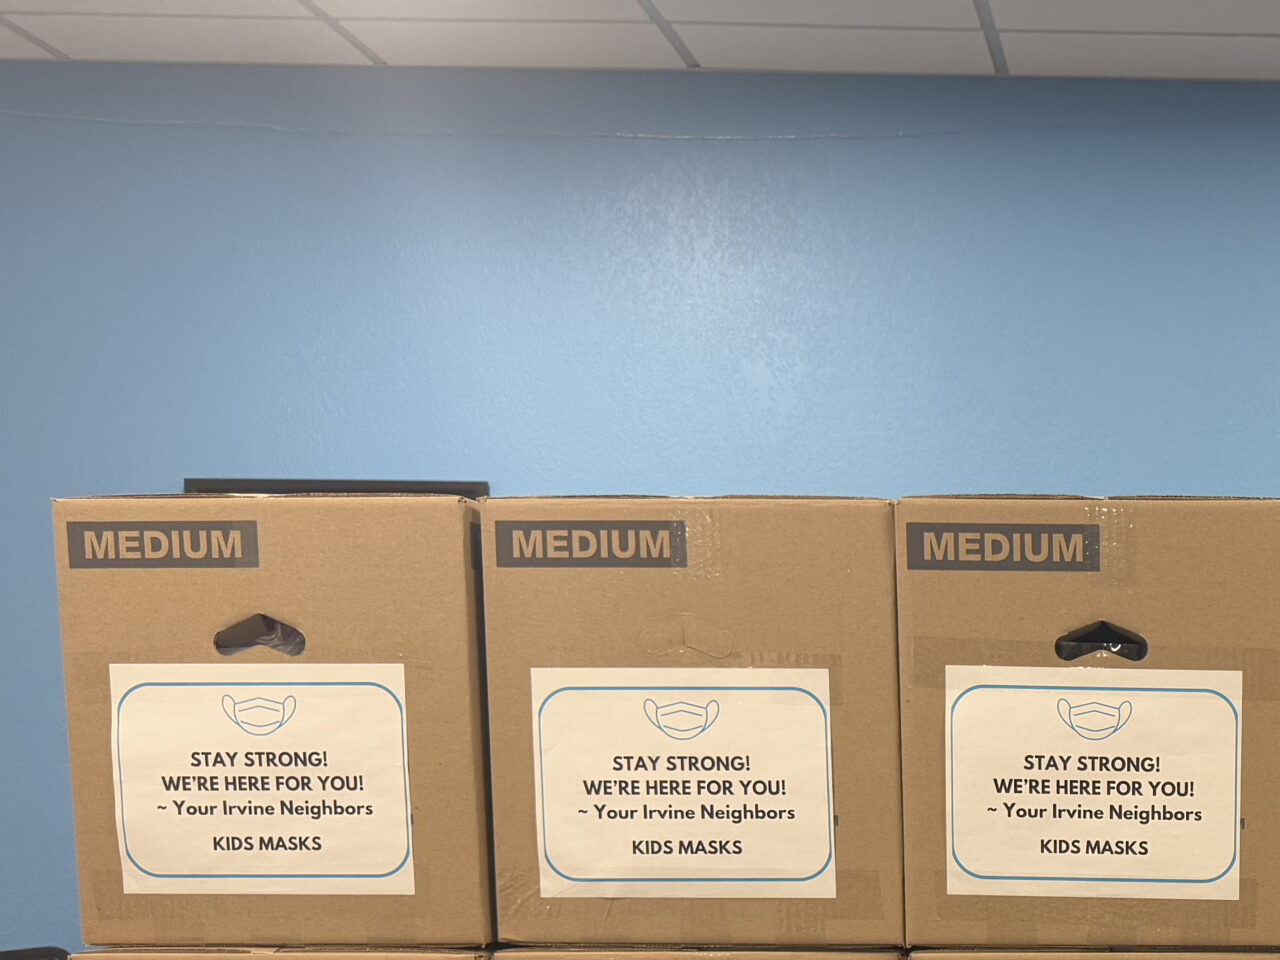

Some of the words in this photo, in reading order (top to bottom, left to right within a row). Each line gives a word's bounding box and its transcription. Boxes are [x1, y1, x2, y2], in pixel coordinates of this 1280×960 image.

[84, 530, 244, 561] MEDIUM
[512, 530, 673, 560] MEDIUM
[924, 532, 1084, 564] MEDIUM
[190, 751, 239, 768] STAY
[244, 750, 328, 768] STRONG!
[612, 755, 661, 772] STAY
[665, 755, 751, 772] STRONG!
[1023, 754, 1073, 771] STAY
[1076, 755, 1161, 773] STRONG!
[161, 775, 220, 792] WE'RE
[224, 775, 271, 792] HERE
[275, 775, 313, 792] FOR
[316, 774, 364, 792] YOU!
[582, 779, 641, 796] WE'RE
[645, 779, 692, 796] HERE
[696, 779, 735, 796] FOR
[738, 779, 787, 796] YOU!
[992, 777, 1051, 795] WE'RE
[1055, 779, 1102, 796] HERE
[1106, 780, 1144, 797] FOR
[1147, 780, 1195, 798] YOU!
[172, 799, 218, 816] Your
[222, 799, 276, 816] Irvine
[279, 799, 374, 820] Neighbors
[593, 803, 639, 820] Your
[643, 803, 696, 820] Irvine
[700, 803, 796, 825] Neighbors
[1002, 802, 1048, 819] Your
[1052, 803, 1105, 820] Irvine
[1109, 804, 1203, 825] Neighbors
[212, 835, 255, 851] KIDS
[258, 835, 322, 851] MASKS
[632, 839, 674, 855] KIDS
[678, 839, 743, 855] MASKS
[1040, 838, 1082, 855] KIDS
[1085, 839, 1149, 856] MASKS
